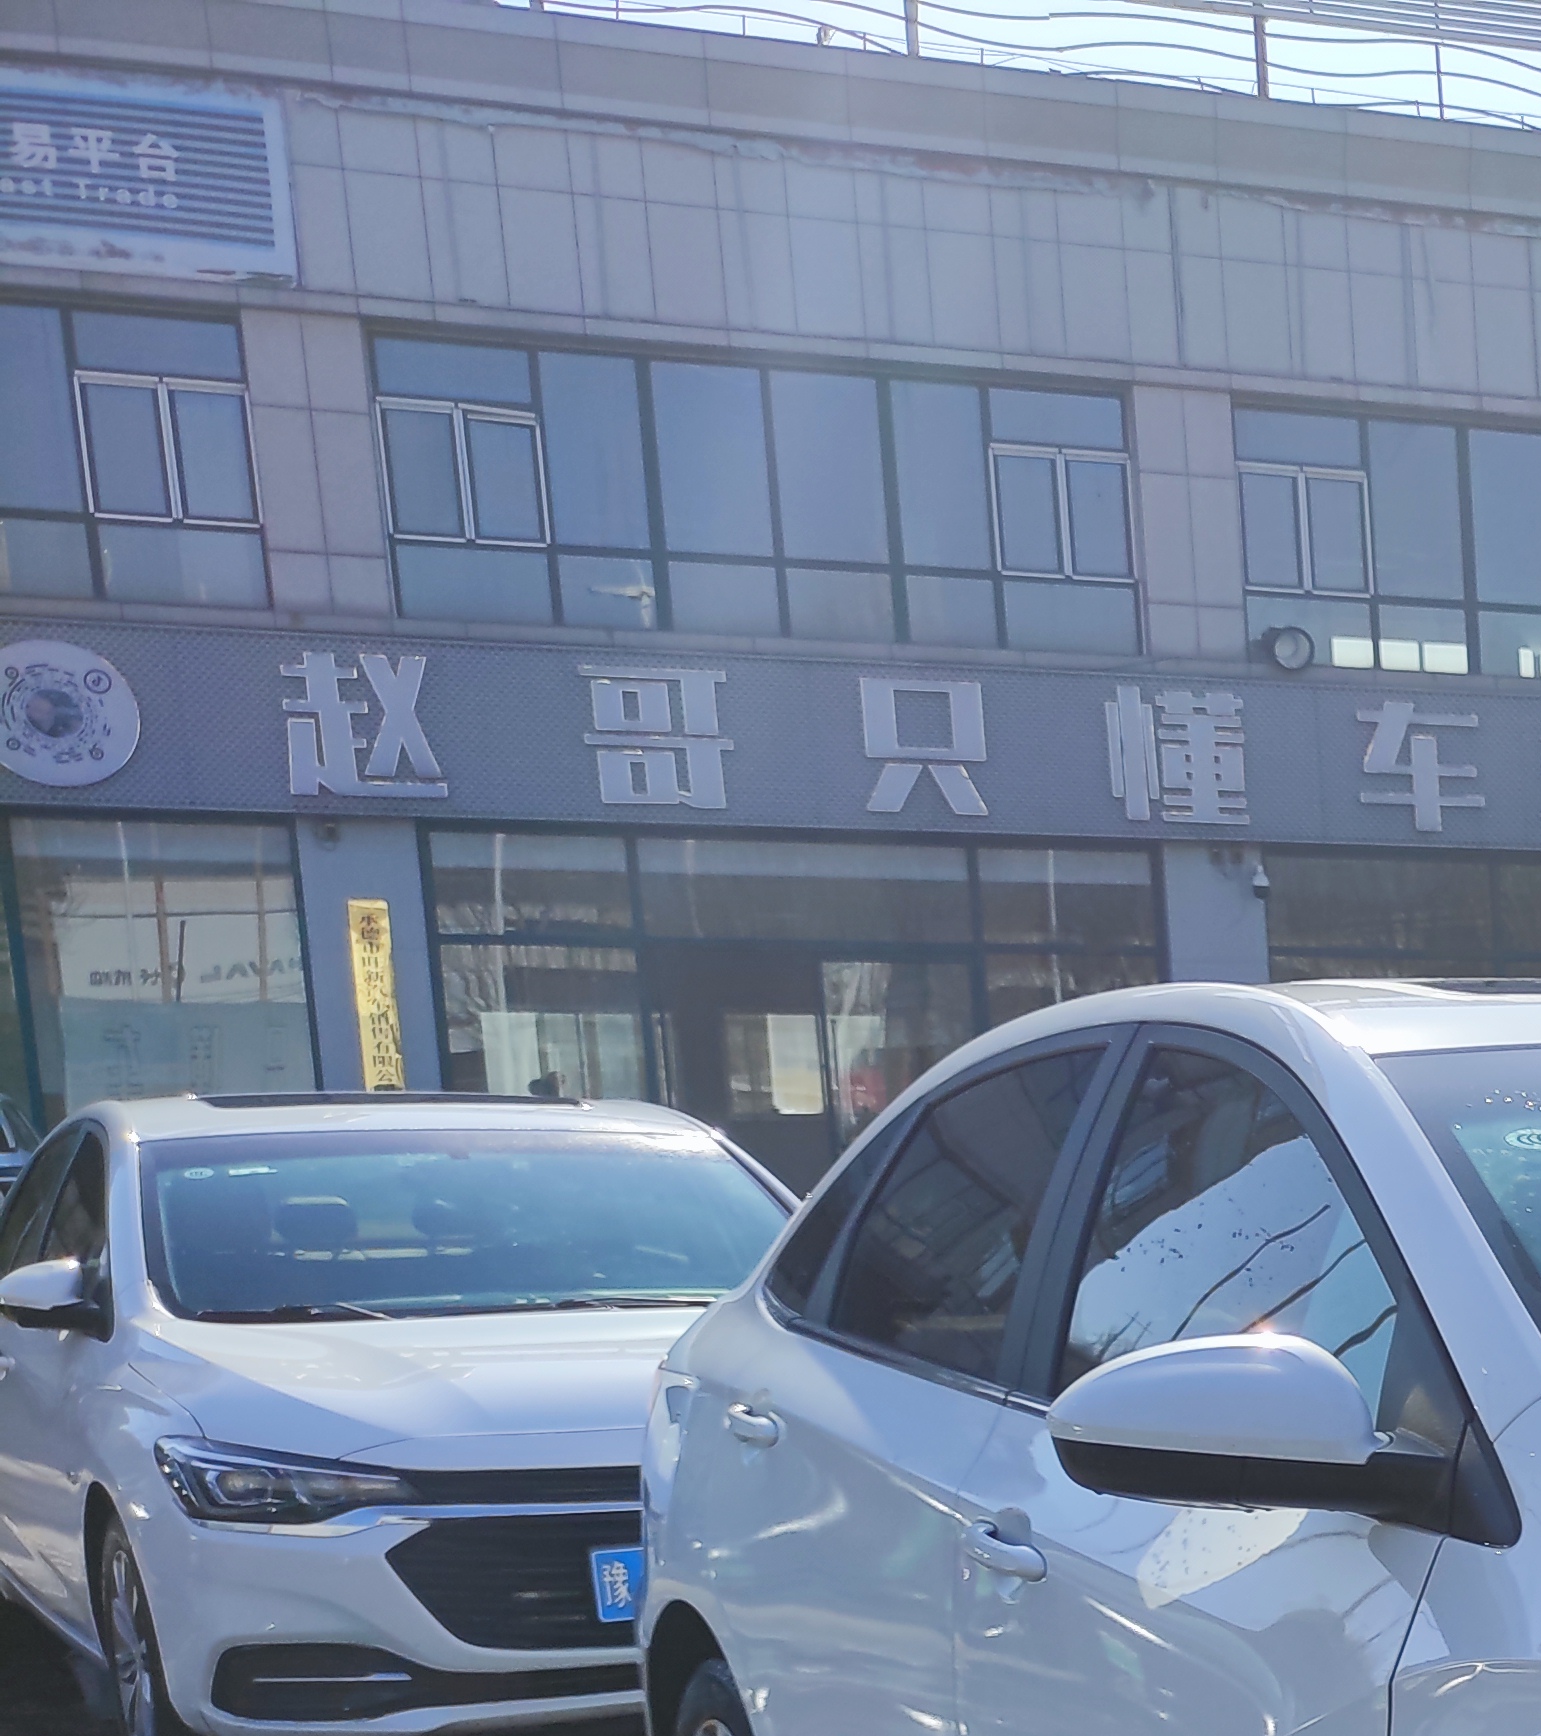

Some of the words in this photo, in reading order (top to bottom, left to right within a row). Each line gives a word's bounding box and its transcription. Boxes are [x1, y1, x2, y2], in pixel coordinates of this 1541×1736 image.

[9, 121, 180, 182] 易平台
[280, 650, 1486, 833] 赵哥只懂车
